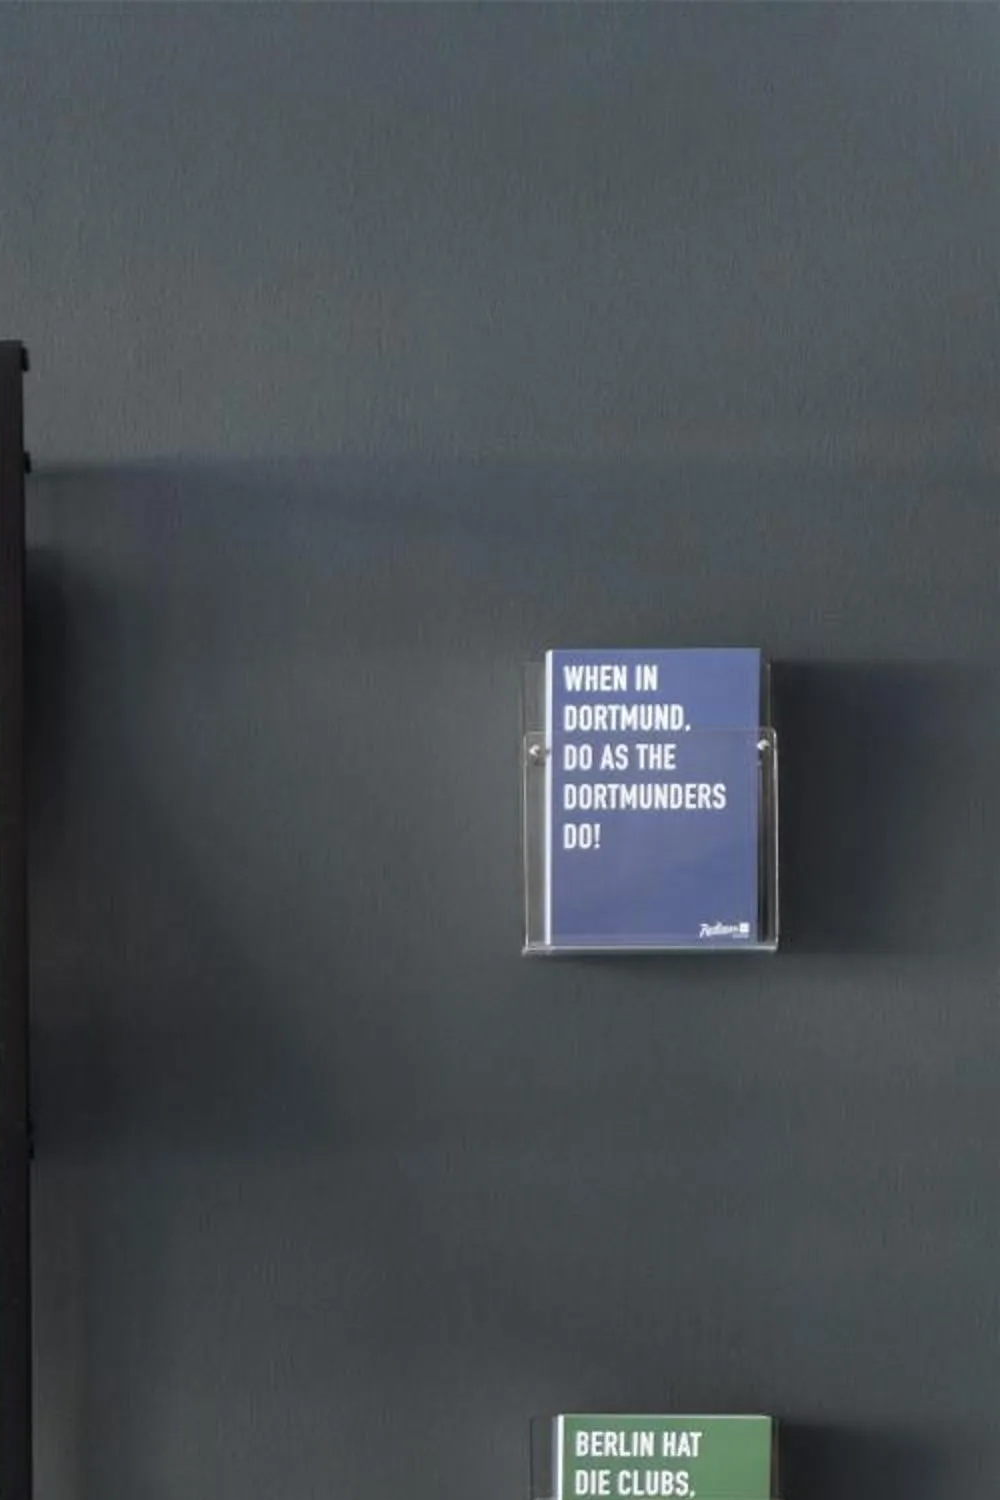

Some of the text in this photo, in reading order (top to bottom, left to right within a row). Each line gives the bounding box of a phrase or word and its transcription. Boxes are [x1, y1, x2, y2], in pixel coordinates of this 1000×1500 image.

[563, 665, 658, 691] WHEN IN
[563, 744, 677, 770] DO AS THE
[563, 783, 727, 809] DORTMUNDERS
[563, 823, 601, 848] DO!
[576, 1431, 702, 1457] BERLIN HAT
[575, 1470, 696, 1497] DIE CLUBS,
